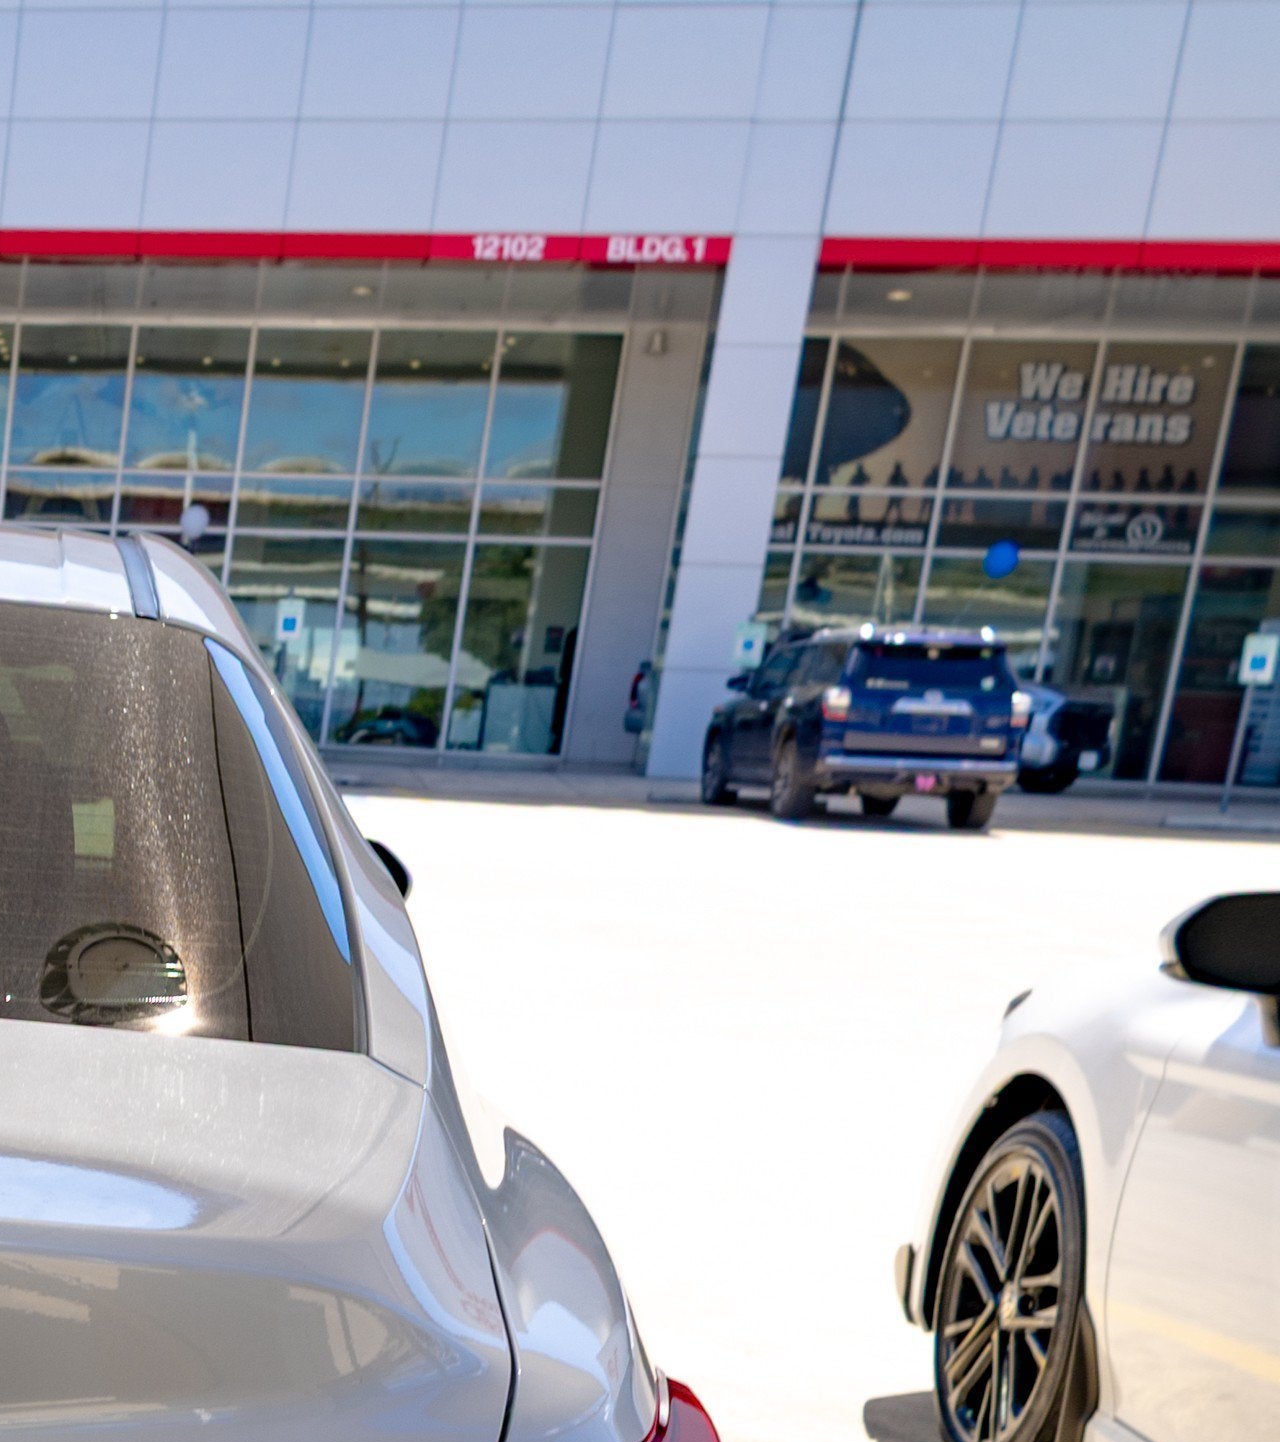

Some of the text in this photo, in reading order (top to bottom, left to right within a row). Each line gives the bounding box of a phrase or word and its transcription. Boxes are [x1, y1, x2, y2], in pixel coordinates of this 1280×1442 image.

[472, 235, 546, 261] 12102
[1019, 362, 1195, 404] We Hire
[986, 401, 1192, 444] Veterans
